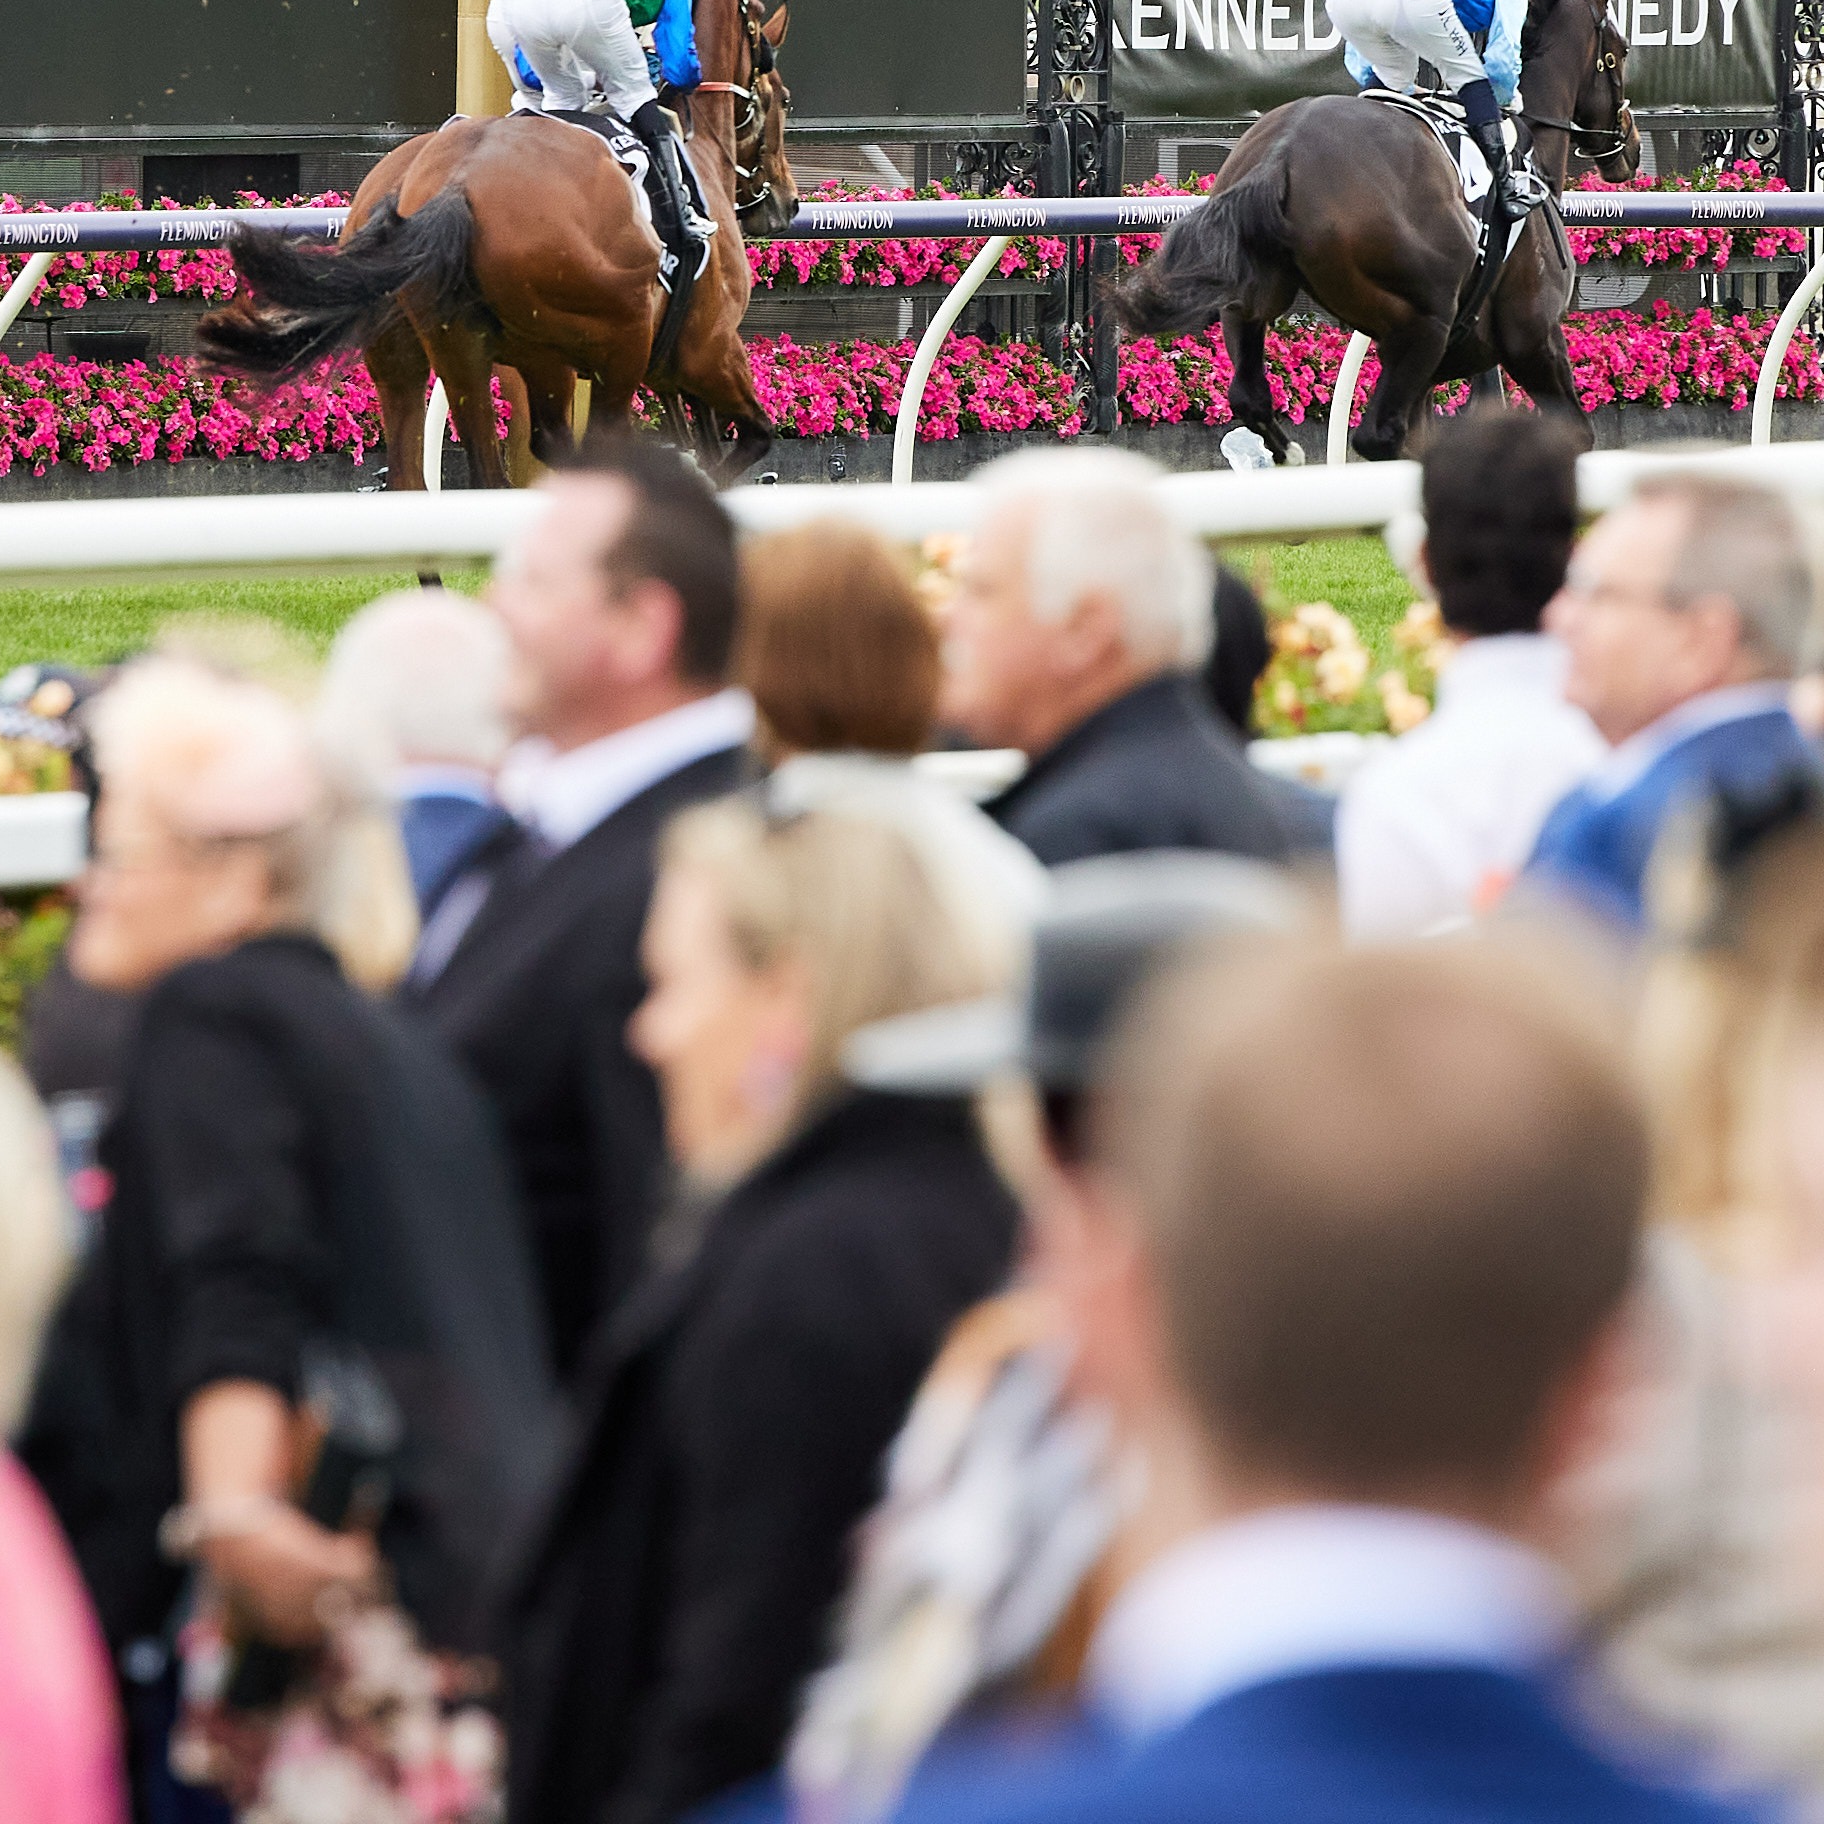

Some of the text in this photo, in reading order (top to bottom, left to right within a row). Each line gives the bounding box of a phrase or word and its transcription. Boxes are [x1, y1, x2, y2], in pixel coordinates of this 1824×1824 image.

[812, 209, 894, 231] FLEMINGTON
[966, 207, 1048, 228] FLEMINGTON
[1691, 200, 1765, 219] FLEMINGTON
